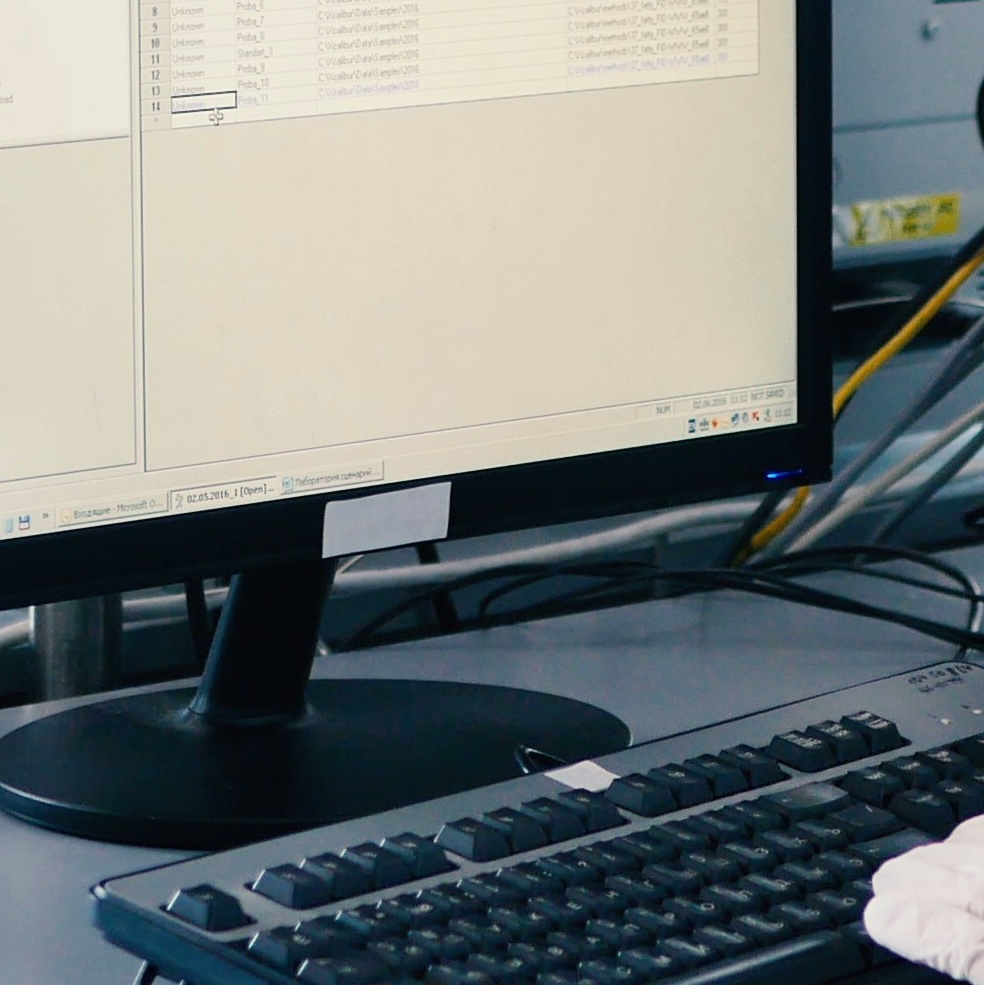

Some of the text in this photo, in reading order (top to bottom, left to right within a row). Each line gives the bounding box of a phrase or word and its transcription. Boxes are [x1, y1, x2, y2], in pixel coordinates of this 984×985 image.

[172, 6, 204, 17] Unknown
[153, 22, 158, 32] 9
[172, 22, 204, 33] Unknown
[152, 38, 160, 48] 10
[173, 38, 204, 49] Unknown
[152, 54, 160, 64] 11
[173, 54, 204, 64] Unknown
[152, 70, 160, 80] 12
[173, 70, 205, 80] Unknown
[152, 86, 160, 96] 13
[152, 102, 160, 112] 14
[117, 500, 148, 512] Microsoft
